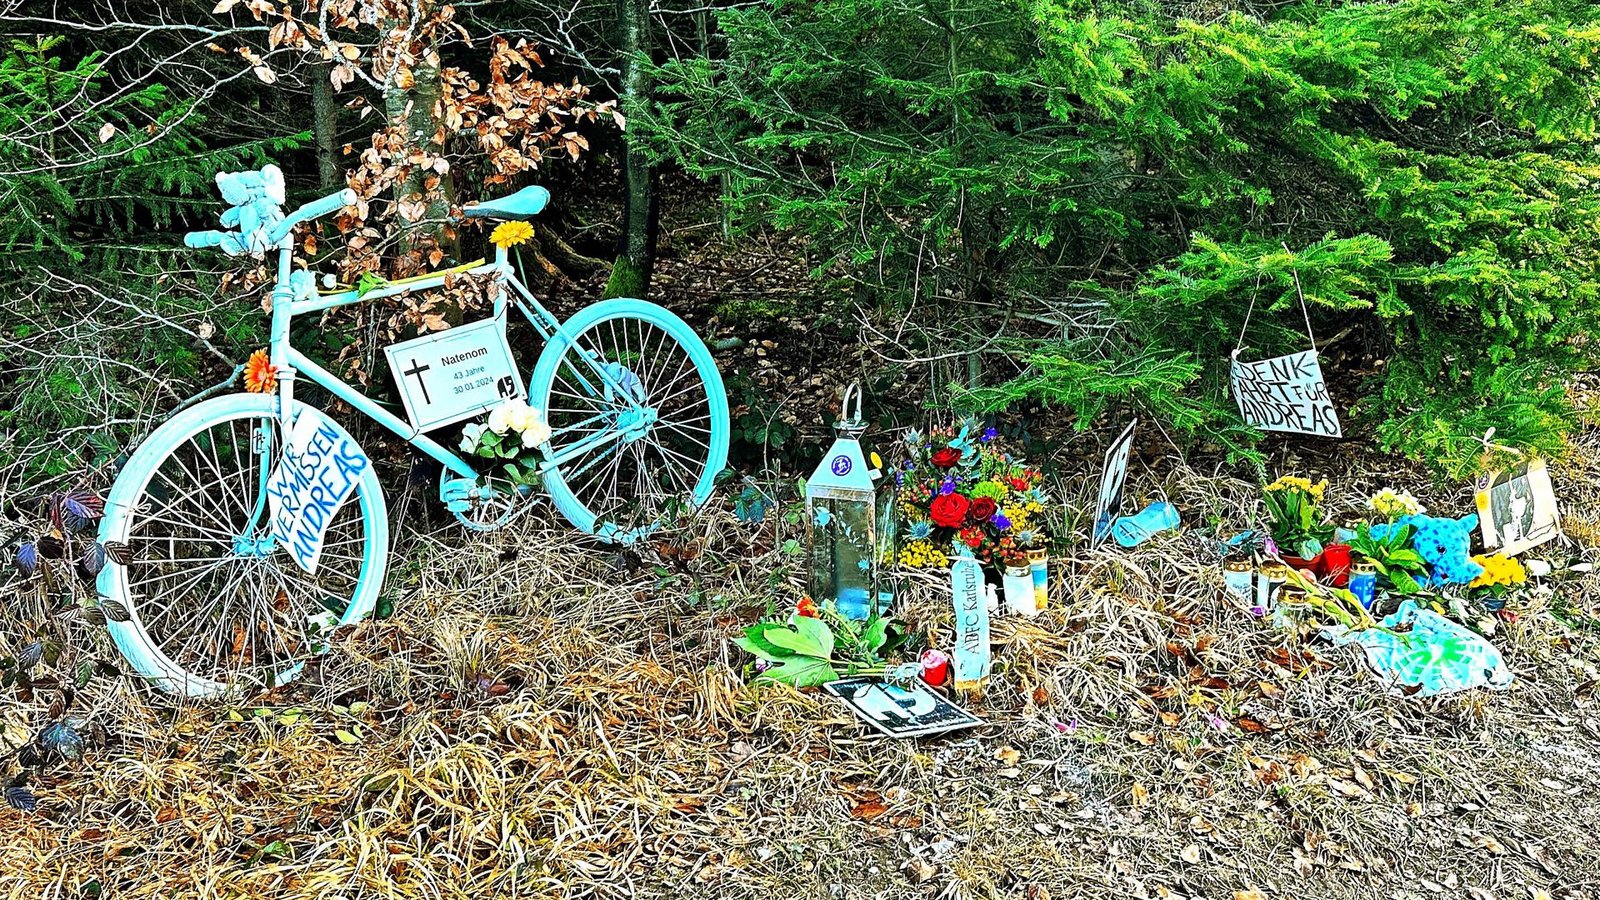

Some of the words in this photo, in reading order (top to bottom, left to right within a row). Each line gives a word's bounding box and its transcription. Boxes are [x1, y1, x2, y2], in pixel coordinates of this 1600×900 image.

[441, 346, 488, 367] Natenom
[453, 371, 464, 381] 43
[465, 365, 485, 377] Jahre
[1290, 381, 1329, 402] FÜR
[1241, 398, 1338, 436] ANDREAS
[266, 442, 301, 498] WIR
[273, 421, 340, 543] VERMISSEN
[293, 439, 368, 570] ANDREAS
[961, 561, 978, 612] Karlsruhe
